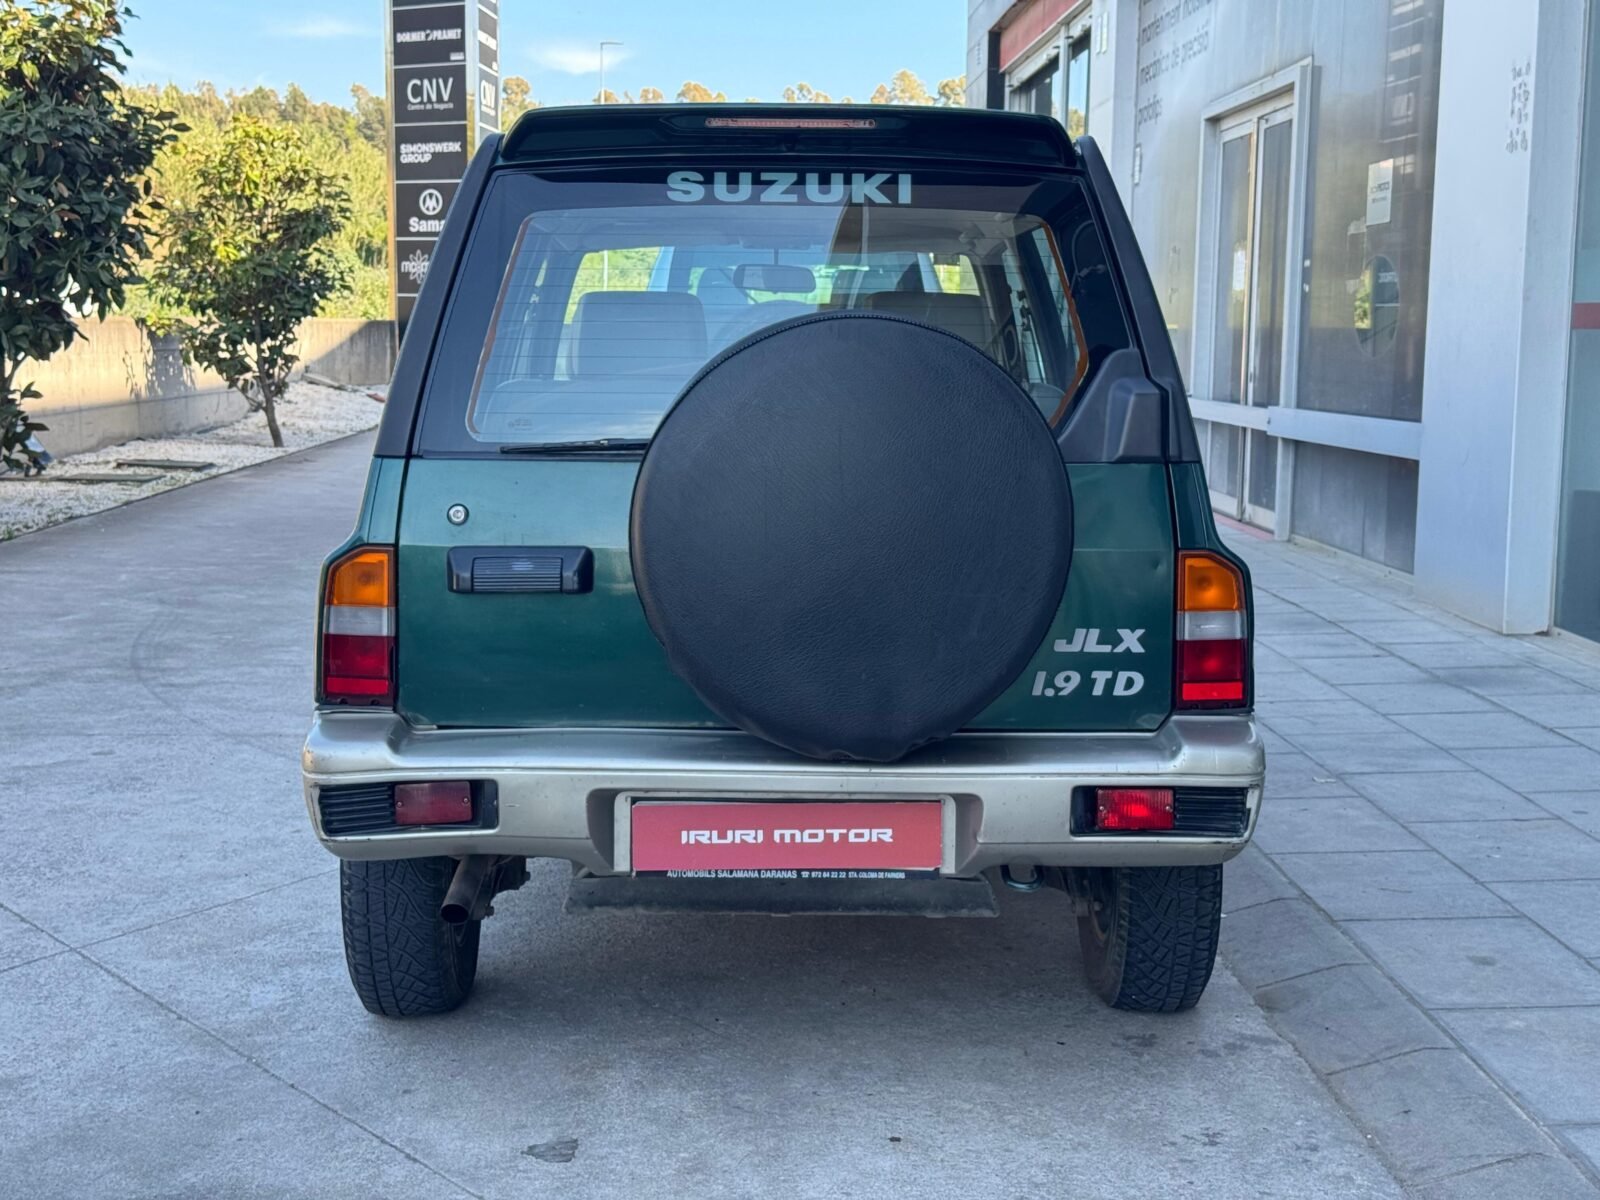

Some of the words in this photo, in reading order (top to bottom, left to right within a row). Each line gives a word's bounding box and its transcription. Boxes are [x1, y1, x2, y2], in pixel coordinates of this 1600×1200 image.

[407, 77, 453, 104] CNV
[400, 141, 462, 154] SIMONSWERK
[400, 153, 432, 164] GROUP
[666, 171, 912, 204] SUZUKI
[1053, 628, 1146, 653] JLX
[1091, 670, 1145, 696] TD
[681, 829, 764, 845] IRURI
[773, 828, 893, 843] MOTOR
[666, 869, 716, 878] AUTOMOBILS
[717, 869, 759, 878] SALAMANA
[761, 870, 797, 879] DARANAS
